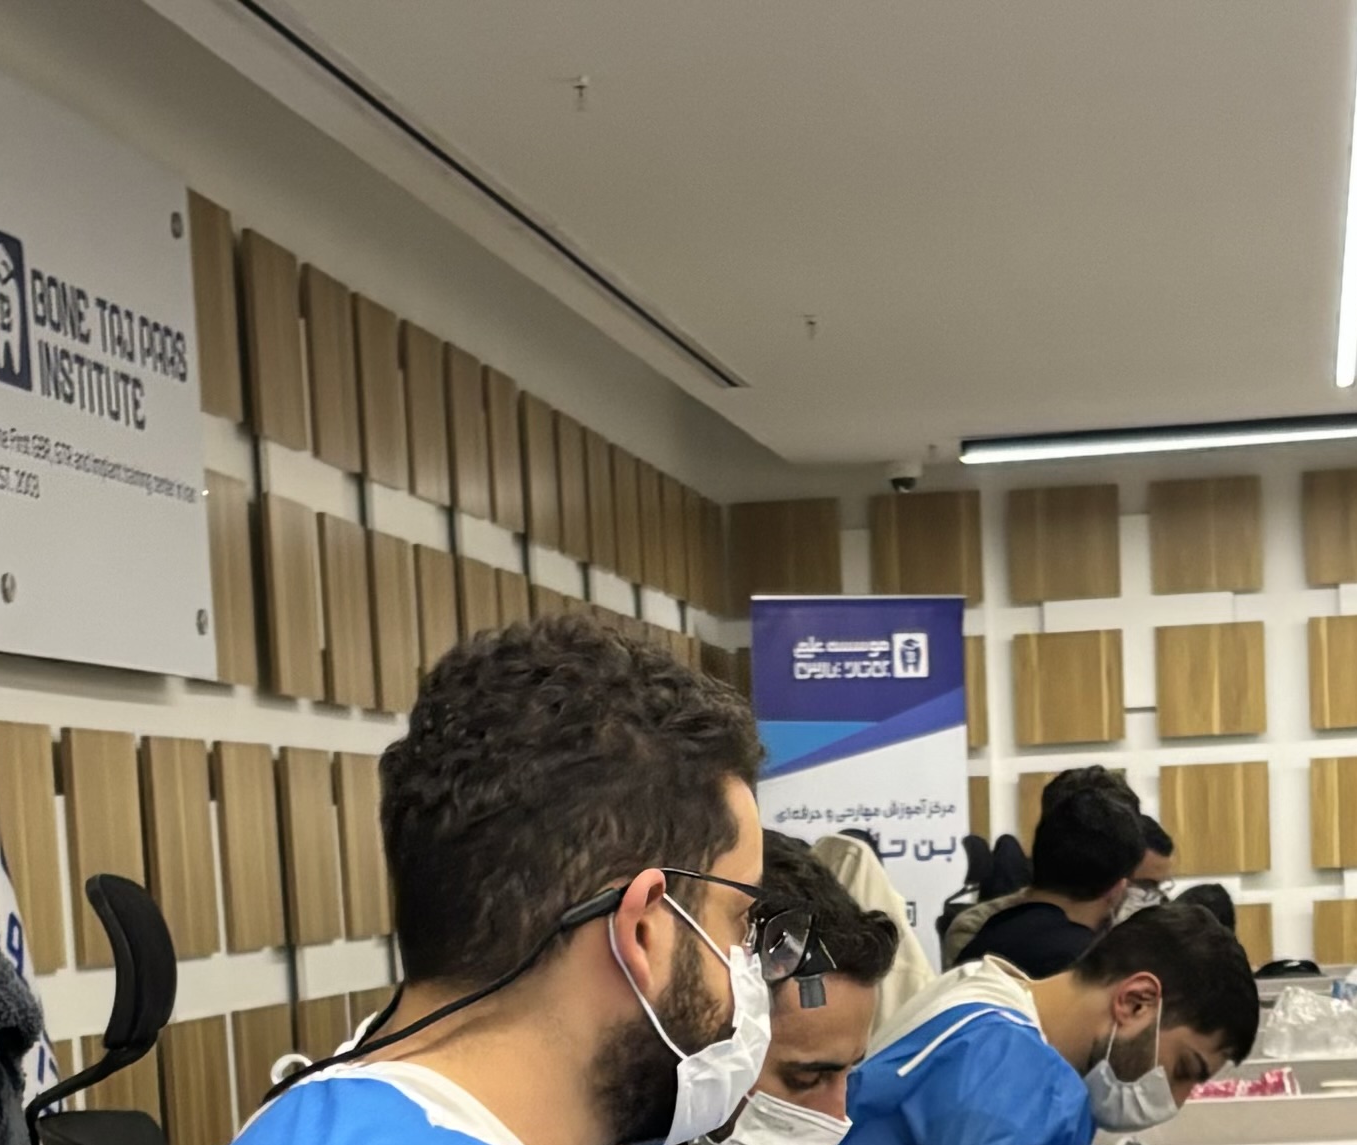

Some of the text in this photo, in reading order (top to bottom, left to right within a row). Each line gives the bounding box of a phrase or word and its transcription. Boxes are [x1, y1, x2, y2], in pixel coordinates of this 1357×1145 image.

[31, 268, 91, 344] BONE
[95, 297, 135, 363] TAJ
[139, 315, 188, 383] PARS
[38, 339, 146, 430] INSTITUTE
[882, 799, 927, 820] آموزش
[928, 801, 956, 819] مرکز
[914, 836, 956, 862] بن
